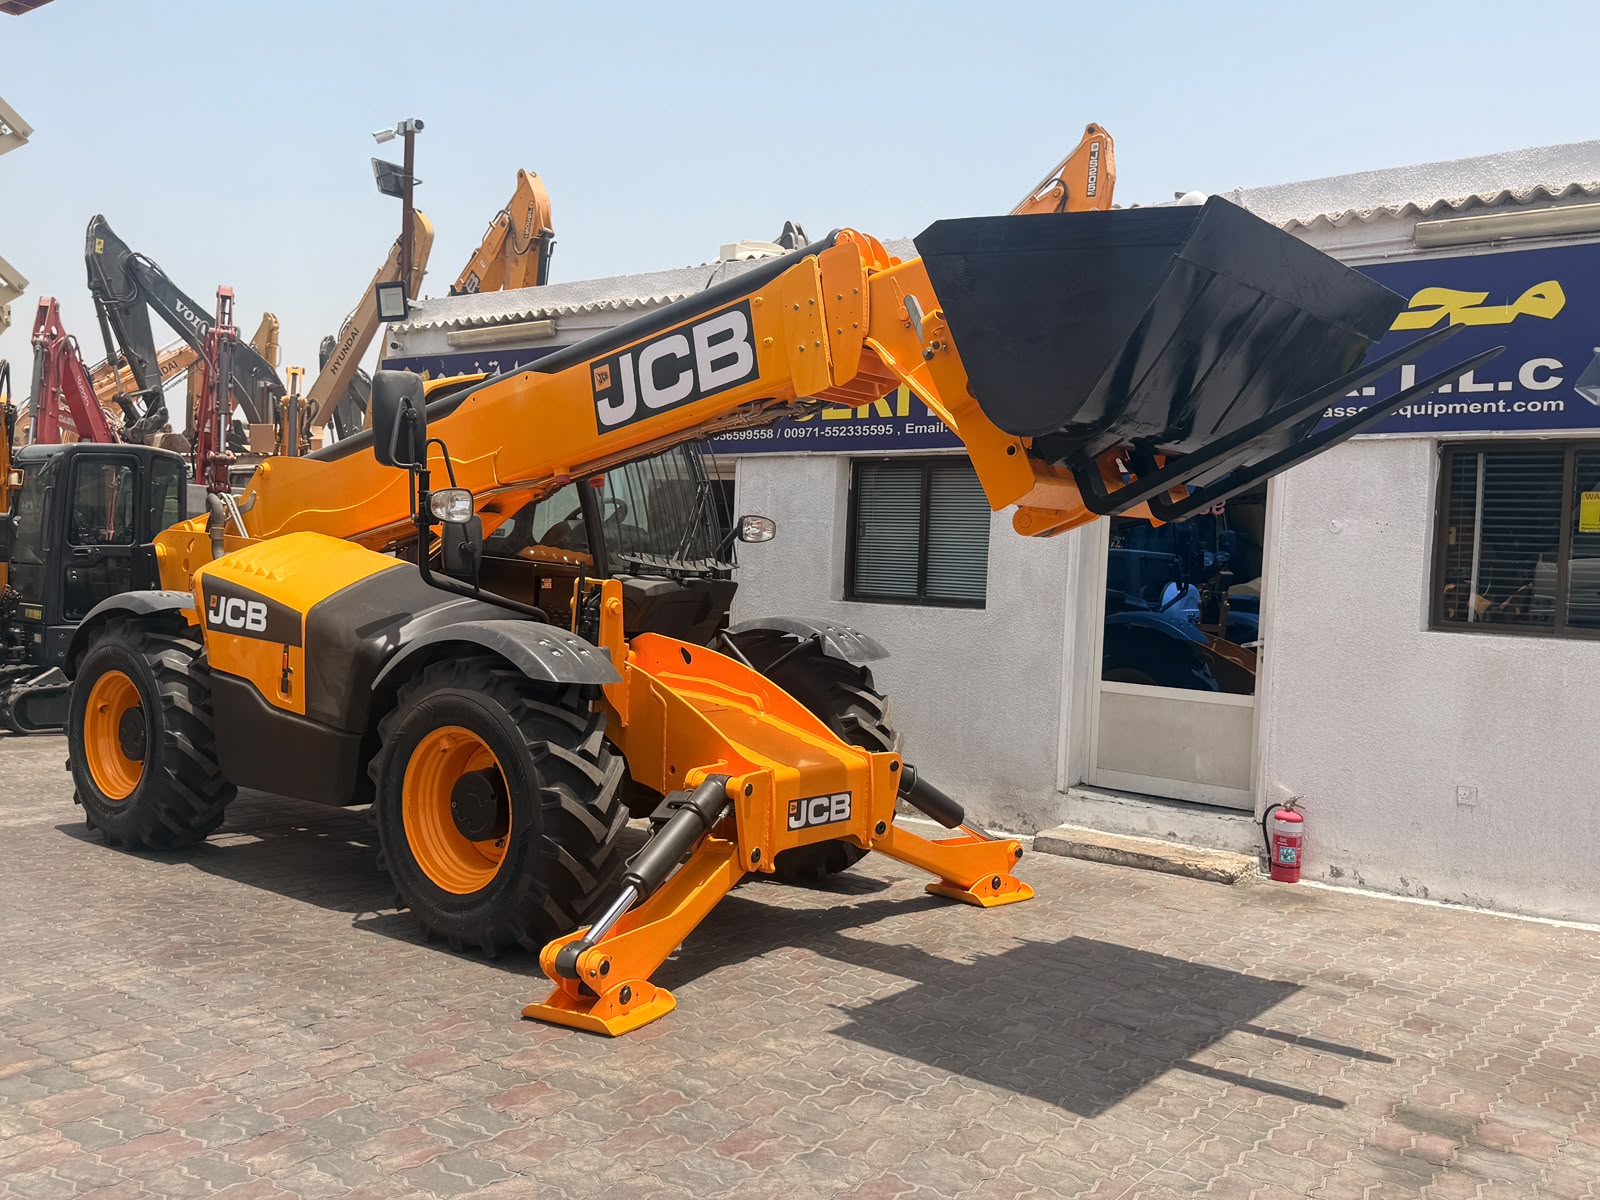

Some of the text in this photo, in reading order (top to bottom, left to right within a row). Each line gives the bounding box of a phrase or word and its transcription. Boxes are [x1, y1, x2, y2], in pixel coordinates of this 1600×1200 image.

[330, 327, 360, 375] HYUNDAI
[597, 310, 754, 426] JCB
[784, 424, 893, 438] 00971-552335595
[905, 422, 948, 434] Email:
[208, 596, 267, 632] JCB
[789, 793, 850, 828] JCB
